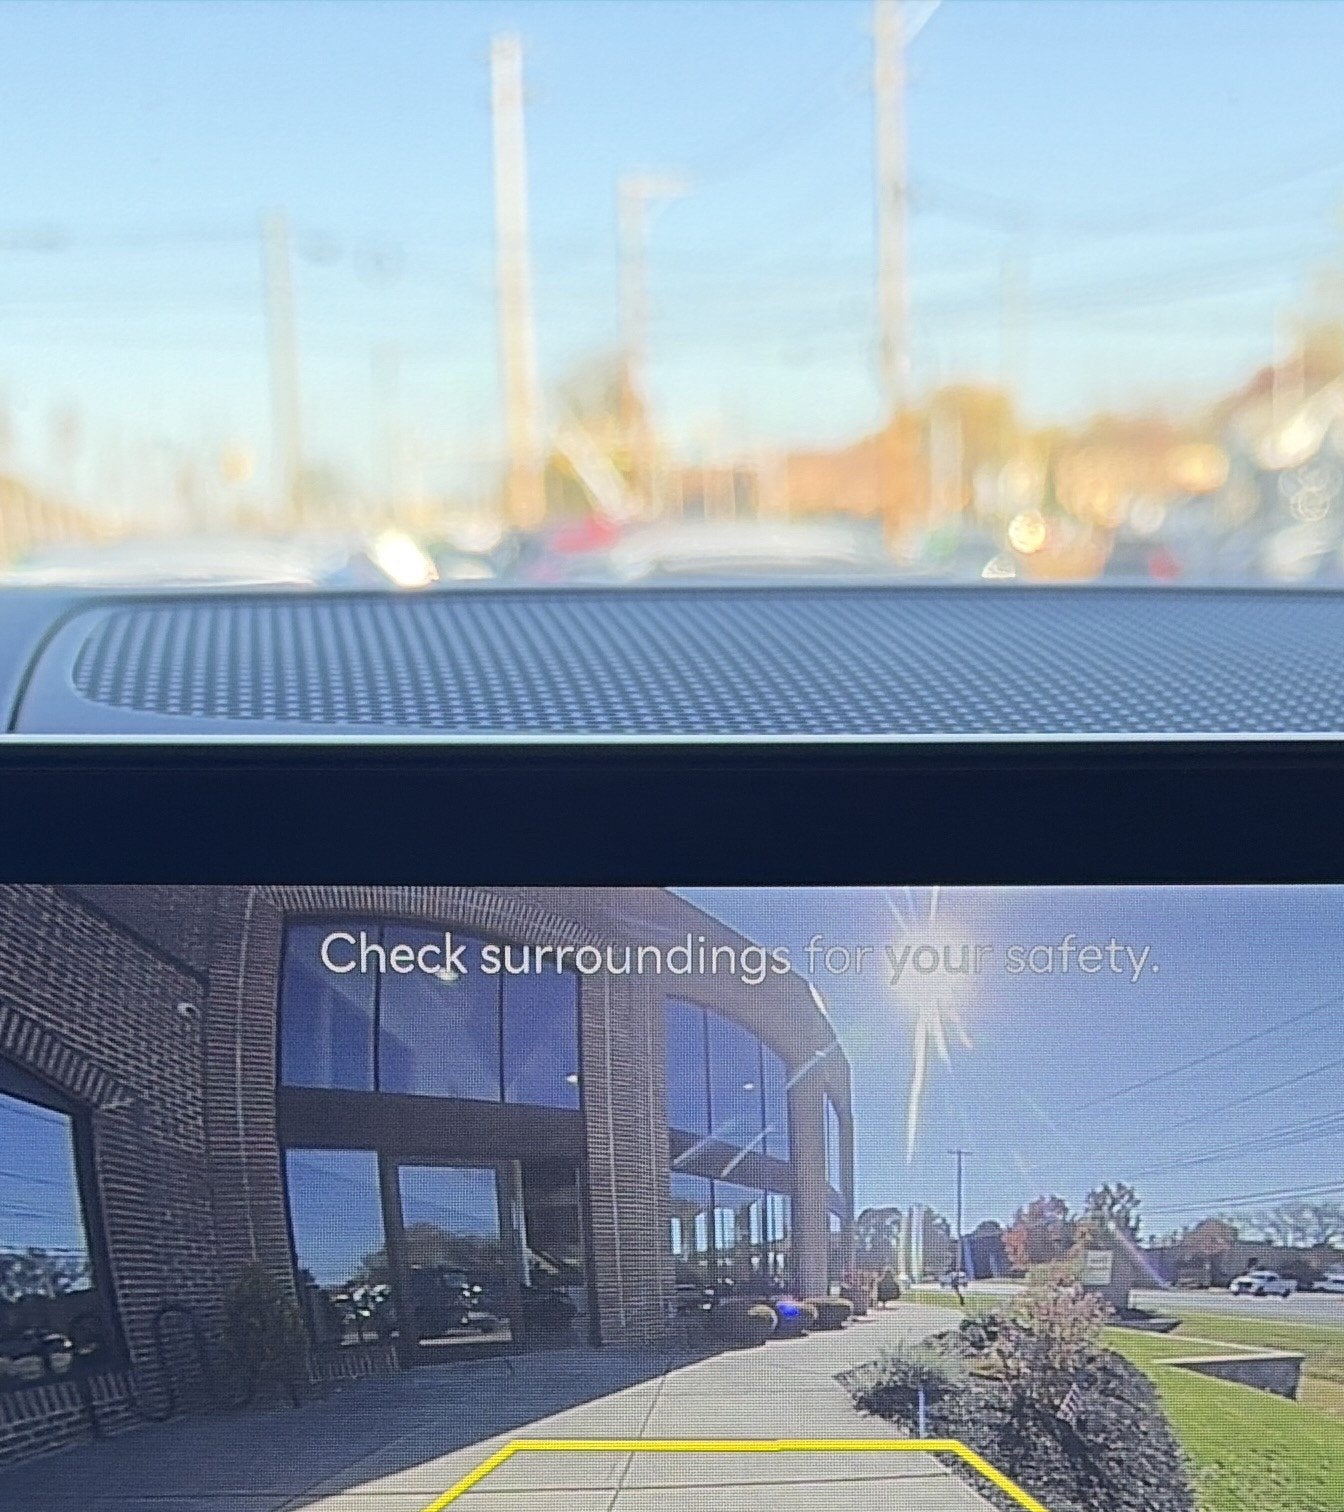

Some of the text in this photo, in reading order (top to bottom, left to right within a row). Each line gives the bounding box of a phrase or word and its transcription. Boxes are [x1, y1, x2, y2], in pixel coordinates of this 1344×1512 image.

[320, 932, 1160, 985] Check surroundings for your safety.
